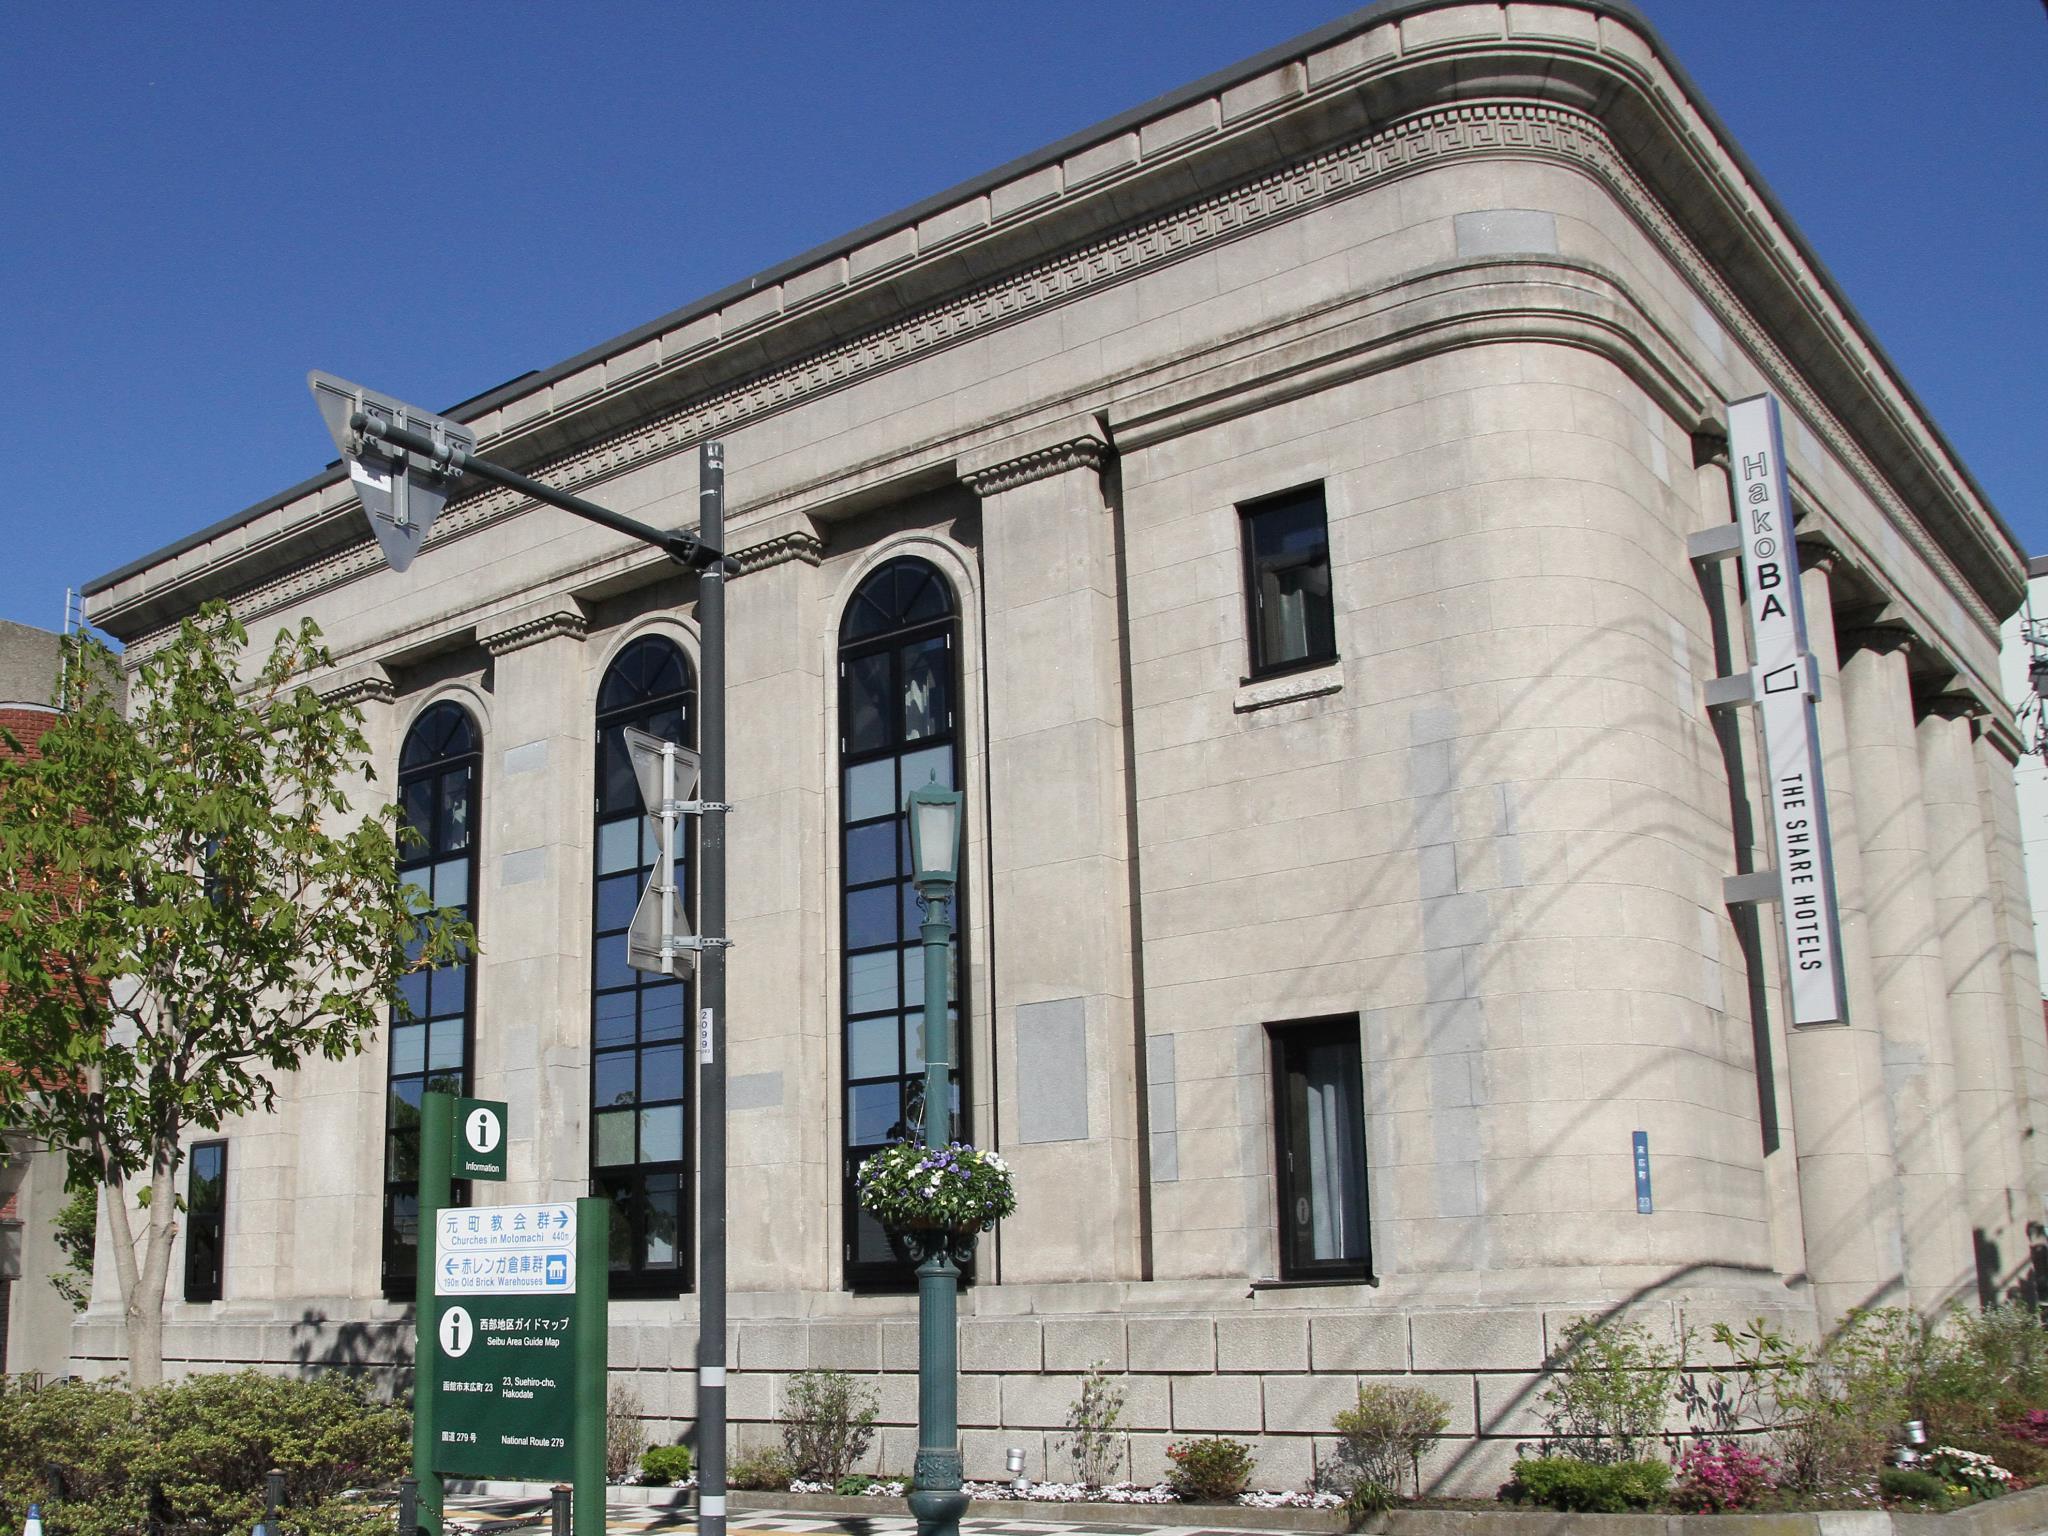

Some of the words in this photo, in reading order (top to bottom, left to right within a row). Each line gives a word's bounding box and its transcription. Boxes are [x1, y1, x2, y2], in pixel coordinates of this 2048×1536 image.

[1743, 451, 1786, 622] HakoBA
[1780, 773, 1806, 810] THE
[1786, 819, 1814, 886] SHARE
[1793, 895, 1823, 971] HOTELS
[465, 1161, 500, 1173] Information
[446, 1211, 550, 1234] 元町教会群
[451, 1235, 488, 1246] Churches
[490, 1236, 498, 1244] in
[500, 1233, 544, 1244] Motomachi
[462, 1255, 544, 1275] 赤レンガ倉庫群
[461, 1277, 474, 1288] Old
[476, 1277, 495, 1287] Brick
[498, 1276, 543, 1287] Warehouses
[480, 1317, 570, 1331] 西部地区ガイドマップ
[487, 1337, 506, 1346] Seibu
[507, 1337, 522, 1346] Area
[524, 1337, 543, 1347] Guide
[545, 1337, 560, 1348] Map
[484, 1383, 494, 1392] 23
[503, 1377, 513, 1386] 23,
[515, 1377, 556, 1388] Suehiro-cho,
[503, 1389, 534, 1399] Hakodate
[456, 1433, 469, 1442] 279
[470, 1433, 477, 1443] 号
[501, 1435, 529, 1446] National
[530, 1437, 550, 1447] Route
[551, 1438, 565, 1447] 279
